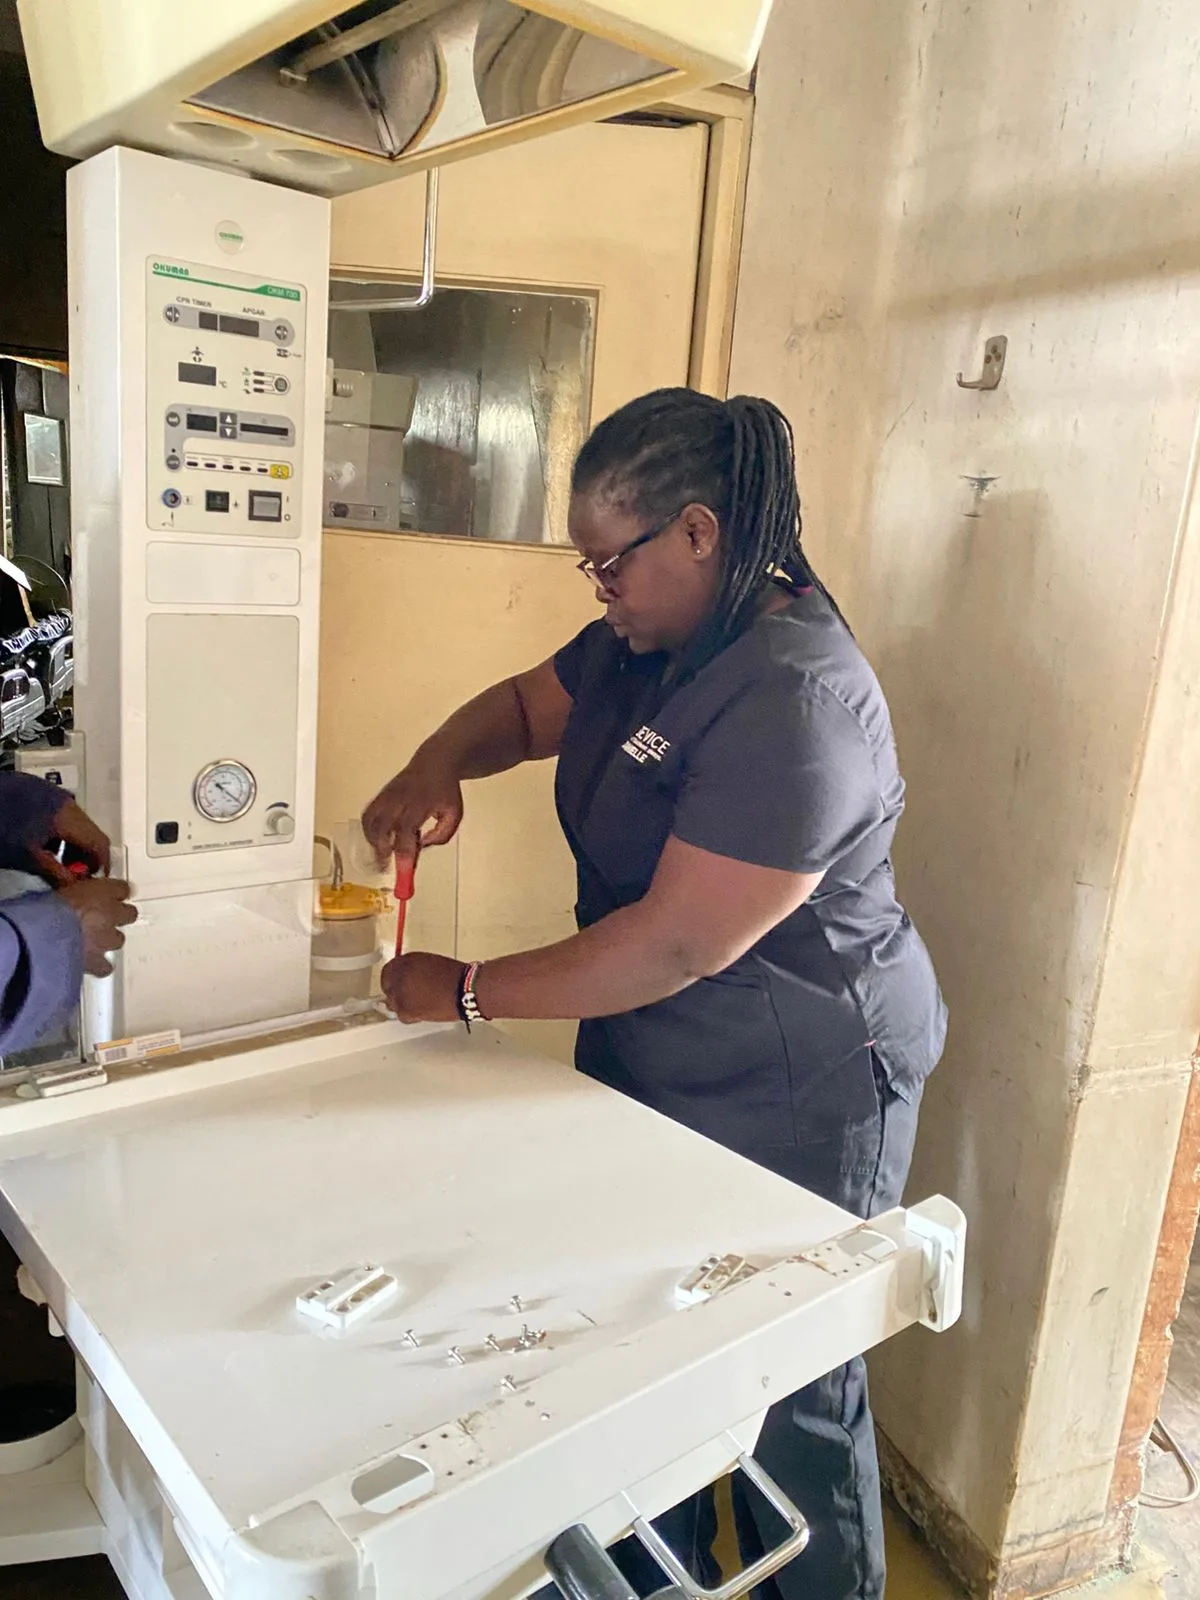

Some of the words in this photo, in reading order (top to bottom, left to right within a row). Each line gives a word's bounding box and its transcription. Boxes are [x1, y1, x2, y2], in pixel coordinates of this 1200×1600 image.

[176, 296, 190, 305] CPR
[192, 298, 212, 308] TIMER
[242, 307, 266, 316] APGAR
